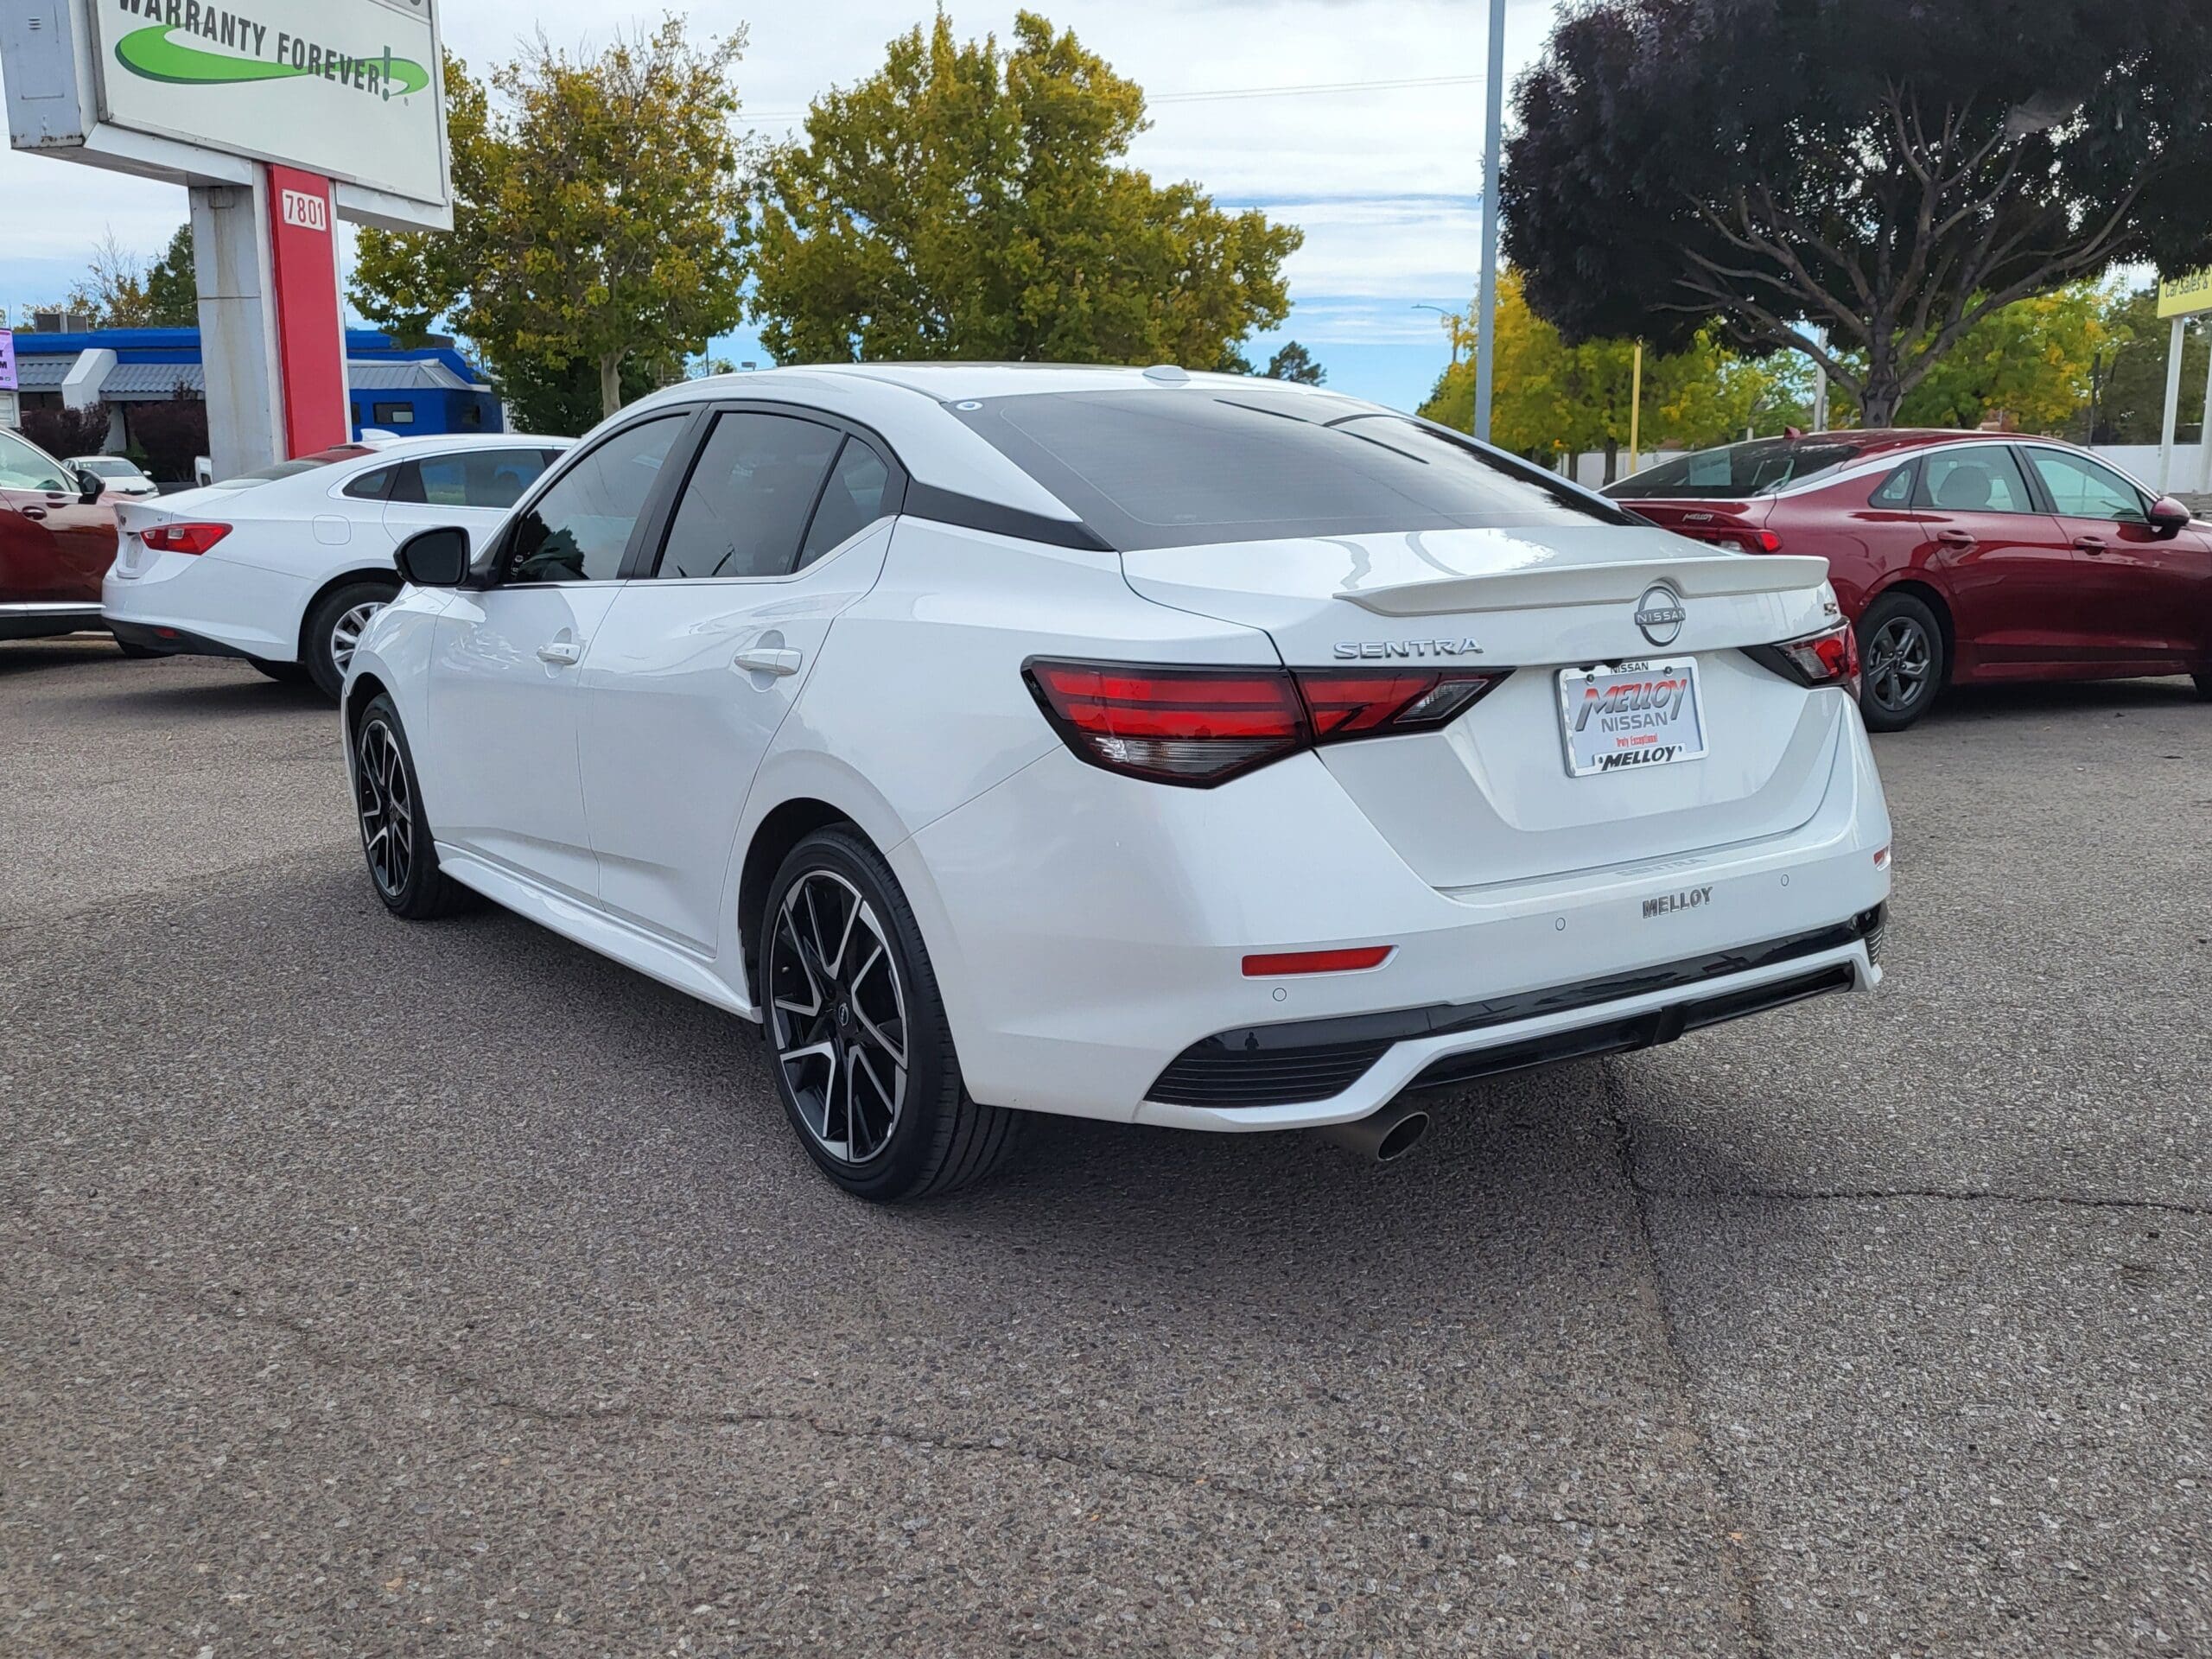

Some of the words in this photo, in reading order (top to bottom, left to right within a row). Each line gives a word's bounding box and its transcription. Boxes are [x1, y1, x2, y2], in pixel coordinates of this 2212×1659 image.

[277, 31, 391, 102] FOREVER!
[285, 194, 323, 226] 7801
[1637, 609, 1685, 623] NISSAN
[1334, 637, 1484, 659] SENTRA
[1610, 662, 1649, 674] NISSAN
[1601, 711, 1668, 733] NISSAN
[1601, 745, 1677, 772] MELLOY
[1643, 886, 1713, 918] MELLOY
